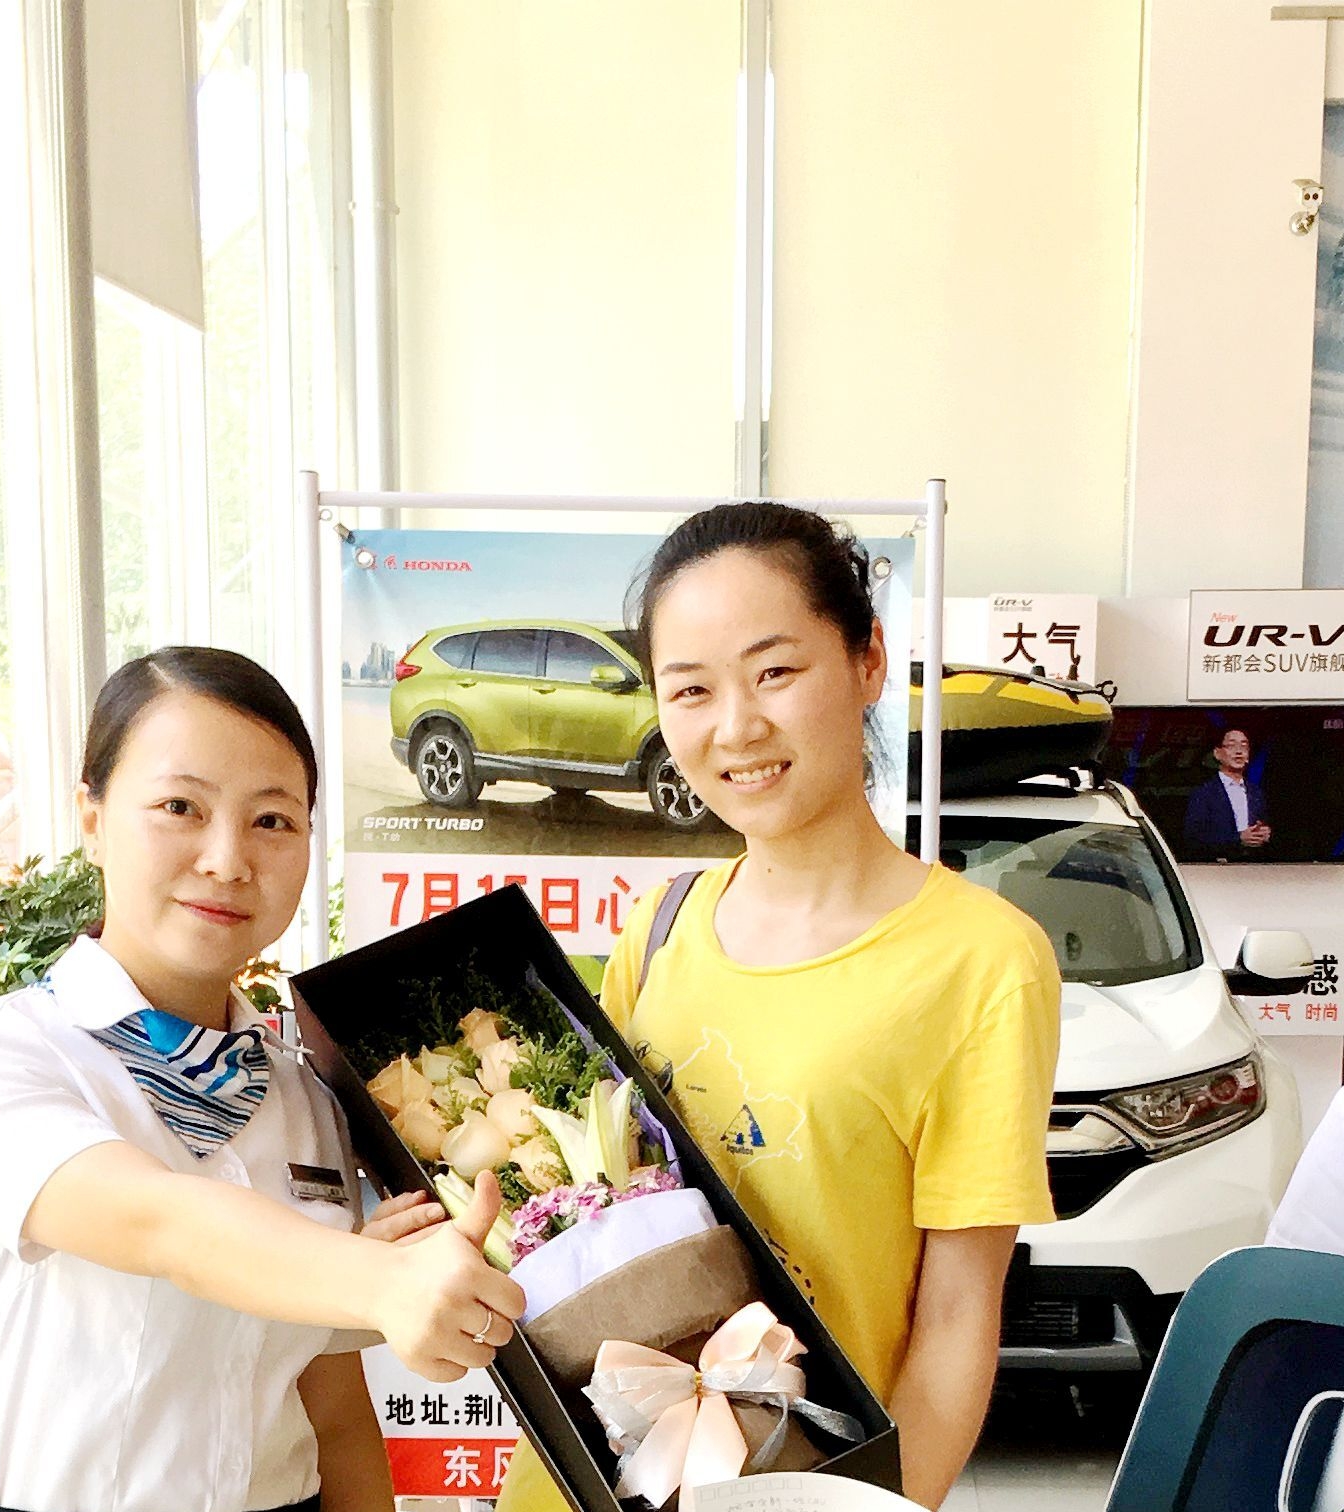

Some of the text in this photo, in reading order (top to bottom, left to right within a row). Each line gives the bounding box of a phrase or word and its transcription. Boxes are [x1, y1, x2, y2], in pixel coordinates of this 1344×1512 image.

[403, 560, 472, 572] HONDA
[1002, 622, 1080, 666] 大气
[363, 817, 484, 831] SPORT TURBO
[1258, 1003, 1339, 1022] 大气 时尚
